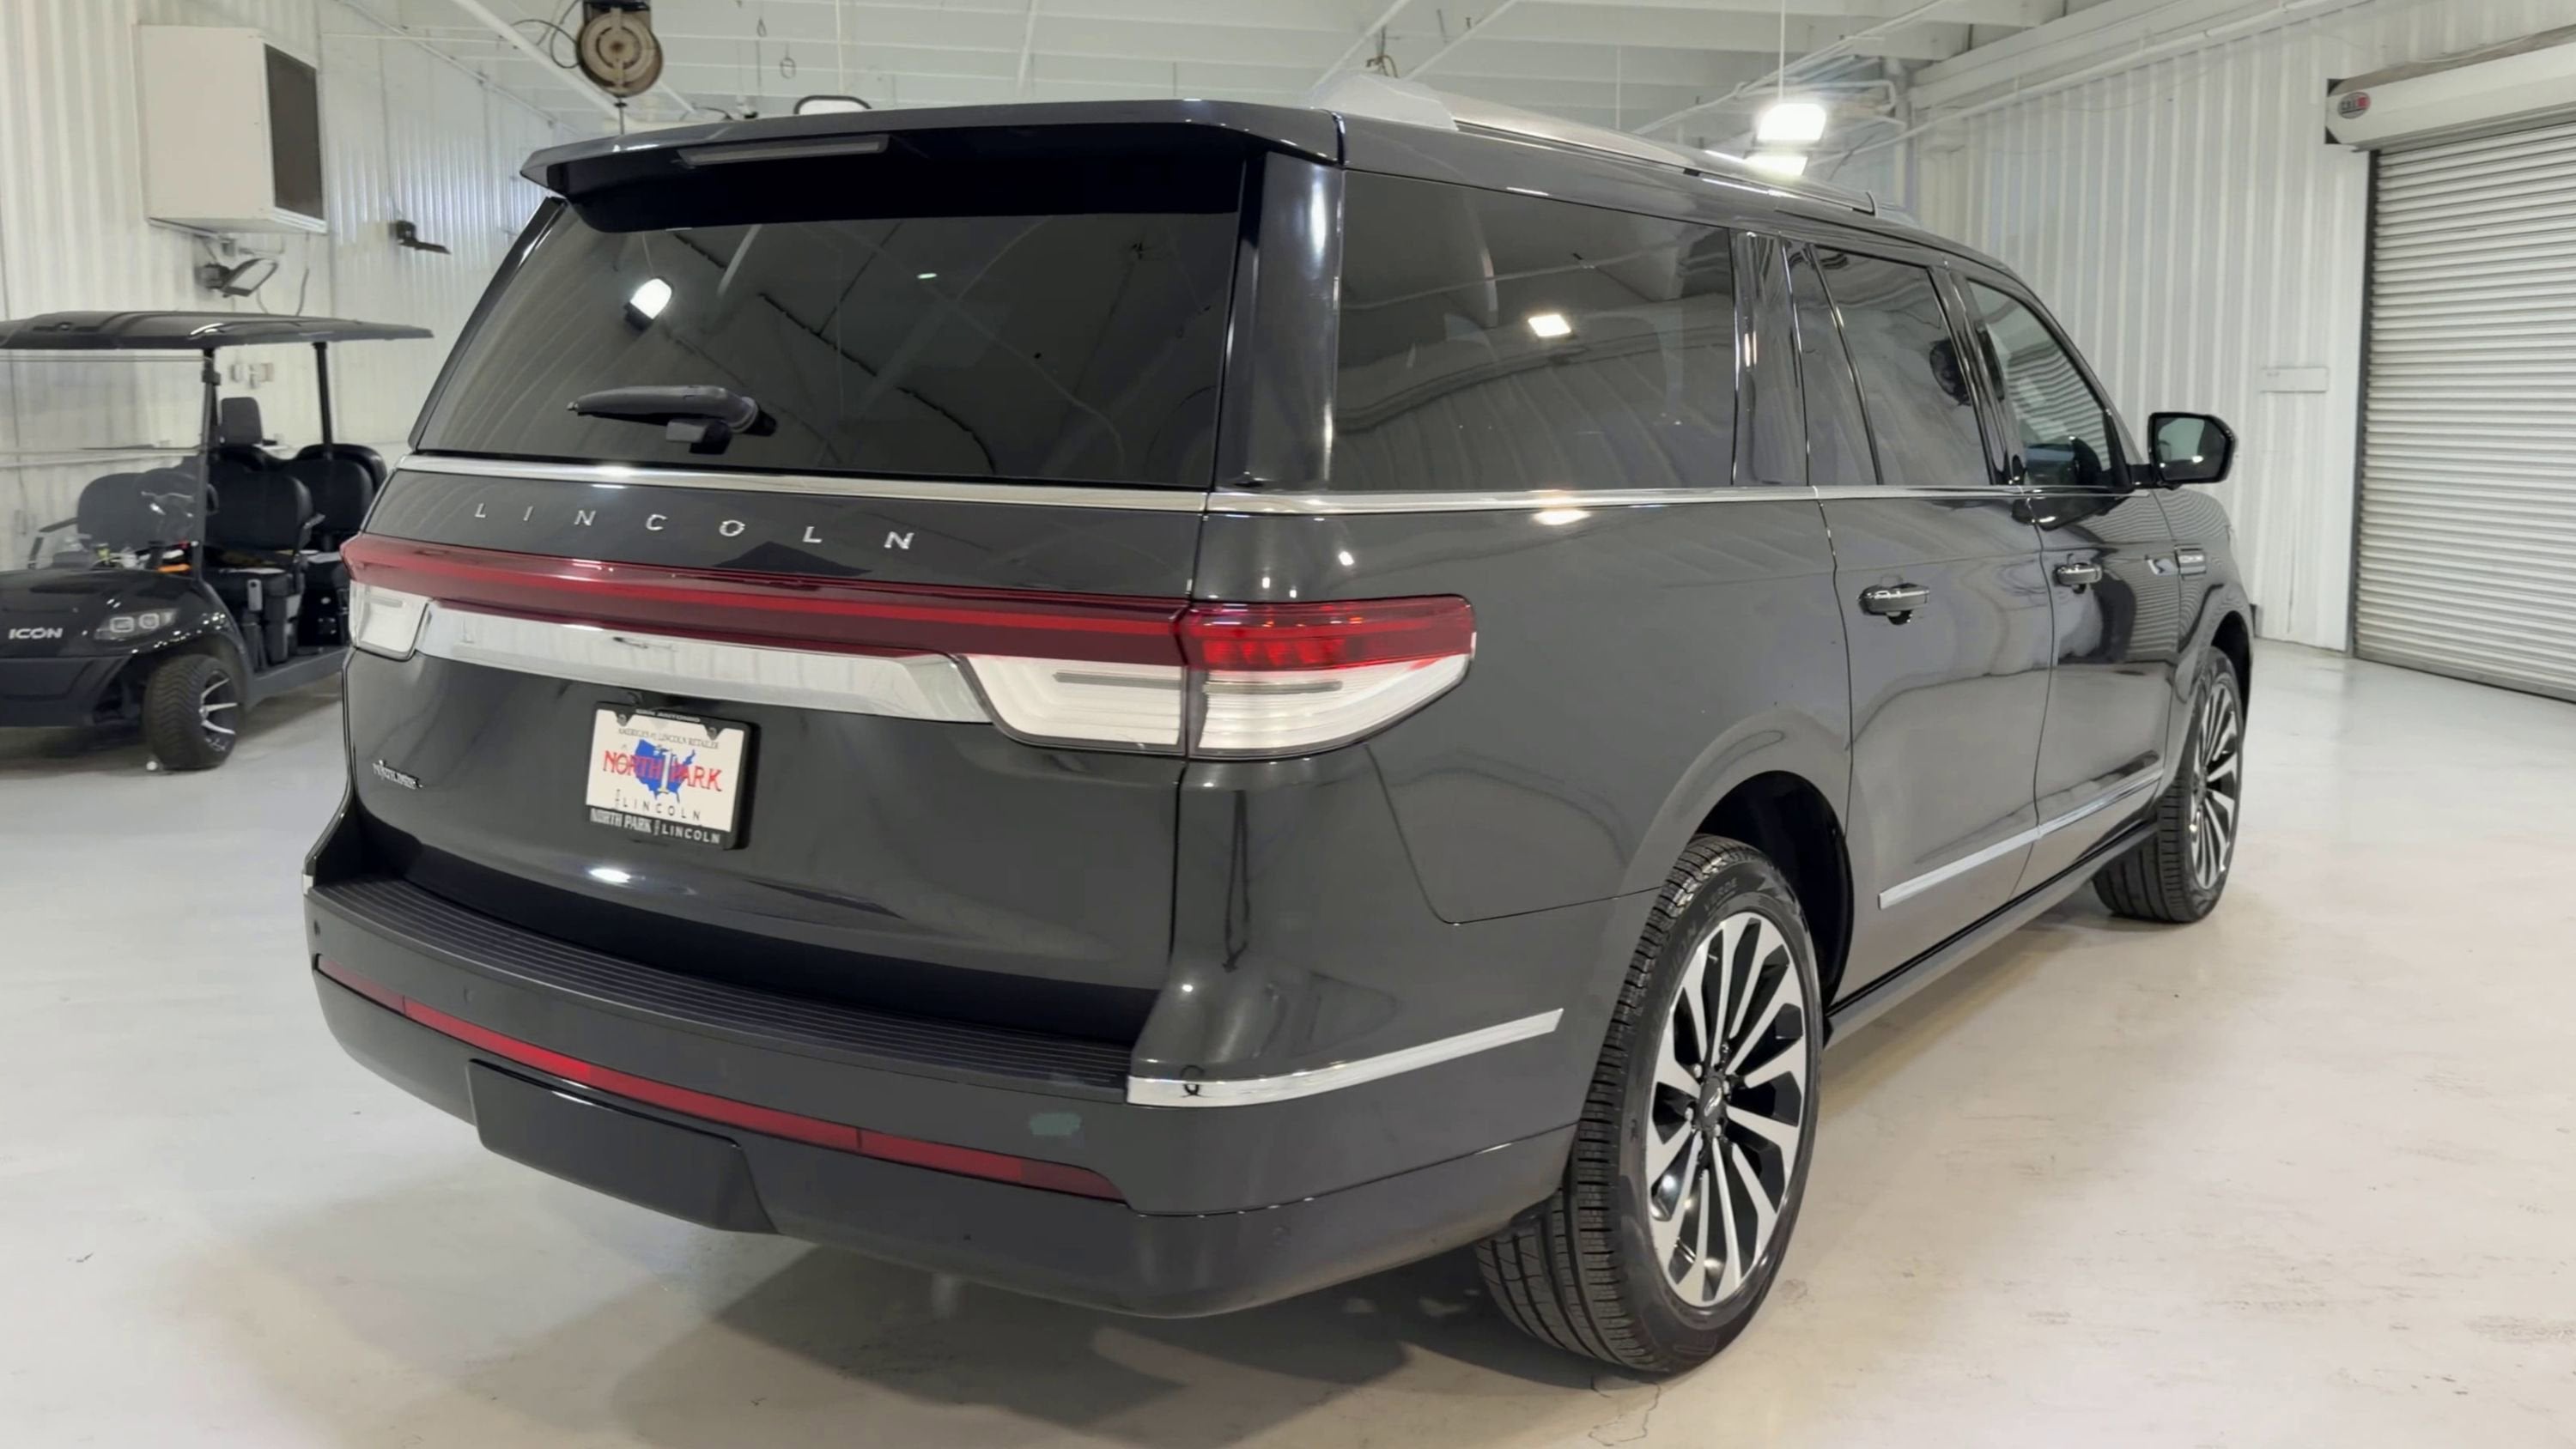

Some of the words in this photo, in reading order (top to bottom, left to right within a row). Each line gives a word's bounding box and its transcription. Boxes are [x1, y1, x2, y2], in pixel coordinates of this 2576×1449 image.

[474, 502, 914, 550] LINCOLN
[9, 627, 64, 640] ICON
[603, 749, 664, 780] NORTH
[669, 758, 723, 792] PARK
[590, 807, 623, 828] NORTH
[623, 814, 652, 834] PARK
[661, 823, 721, 845] LINCOLN
[623, 797, 702, 822] LINCOLN
